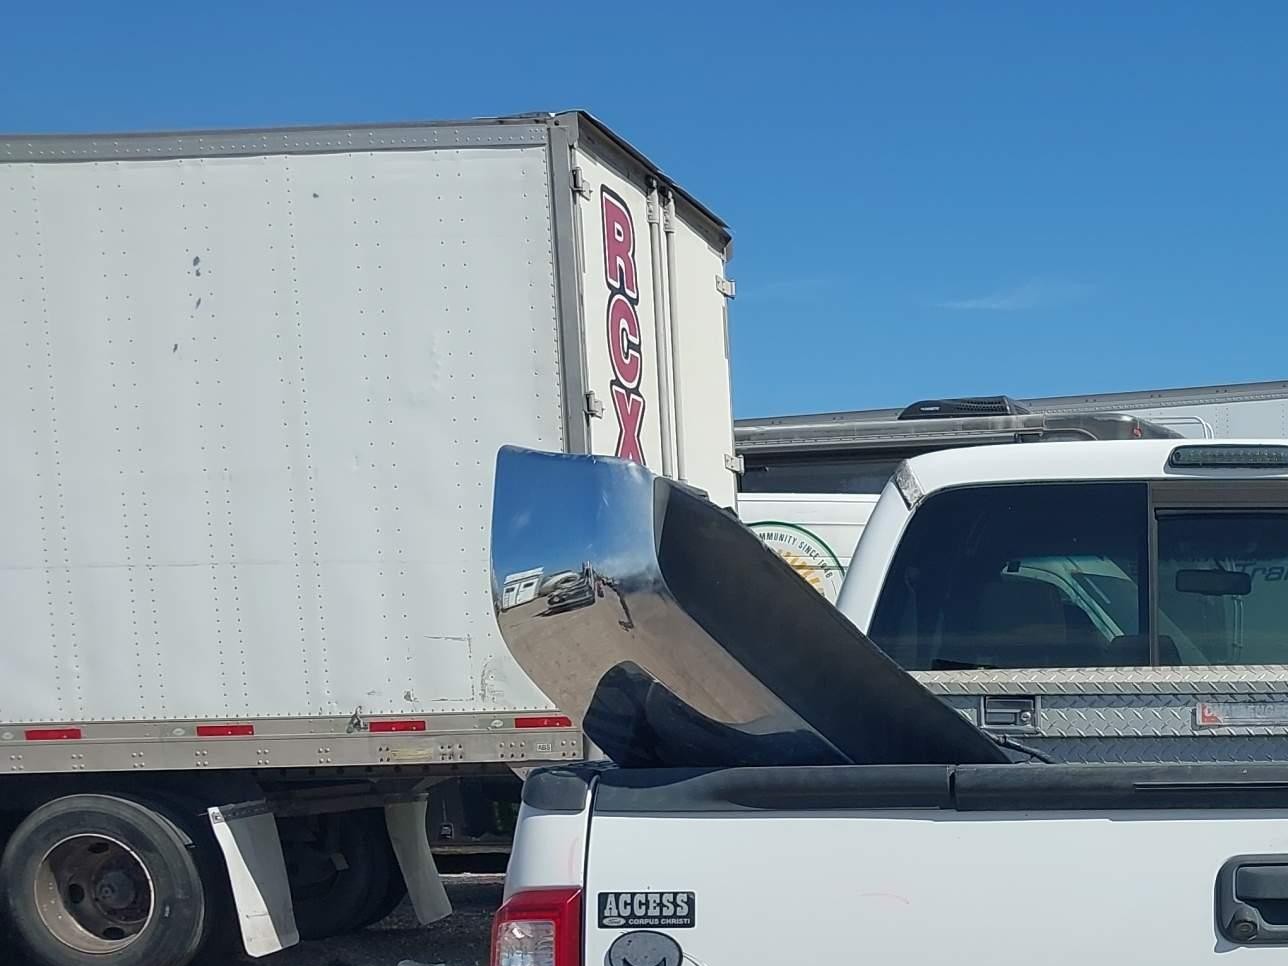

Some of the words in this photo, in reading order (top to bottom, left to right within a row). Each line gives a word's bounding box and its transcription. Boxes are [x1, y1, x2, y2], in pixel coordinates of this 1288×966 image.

[600, 183, 646, 467] RCX
[759, 532, 797, 545] MMUNITY
[798, 541, 820, 560] SINCE
[603, 892, 690, 917] ACCESS
[660, 917, 691, 925] CHRISTI
